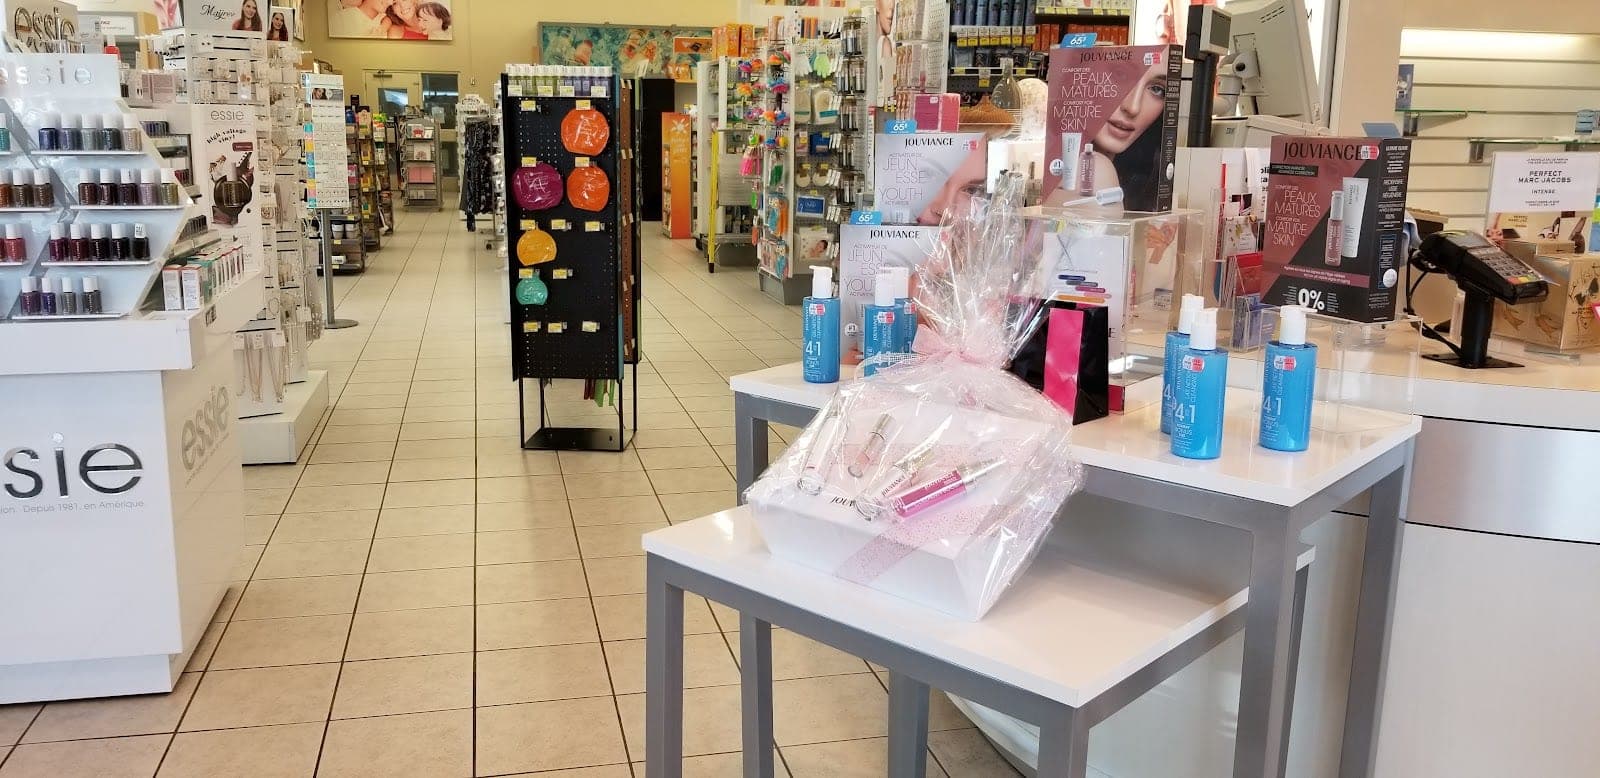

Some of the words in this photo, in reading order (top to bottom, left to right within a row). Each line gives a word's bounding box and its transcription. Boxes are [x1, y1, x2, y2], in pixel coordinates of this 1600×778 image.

[1073, 72, 1113, 84] PEAUX
[1061, 85, 1118, 98] MATURES
[1053, 105, 1101, 118] MATURE
[1060, 119, 1087, 131] SKIN
[1283, 141, 1362, 162] JOUVIANCE
[879, 187, 923, 200] YOUTH
[1284, 190, 1317, 203] PEAUX
[1274, 201, 1321, 218] MATURES
[870, 229, 920, 240] JOUVIANCE
[1268, 220, 1307, 236] MATURE
[1272, 233, 1295, 247] SKIN
[1298, 288, 1325, 311] 0%
